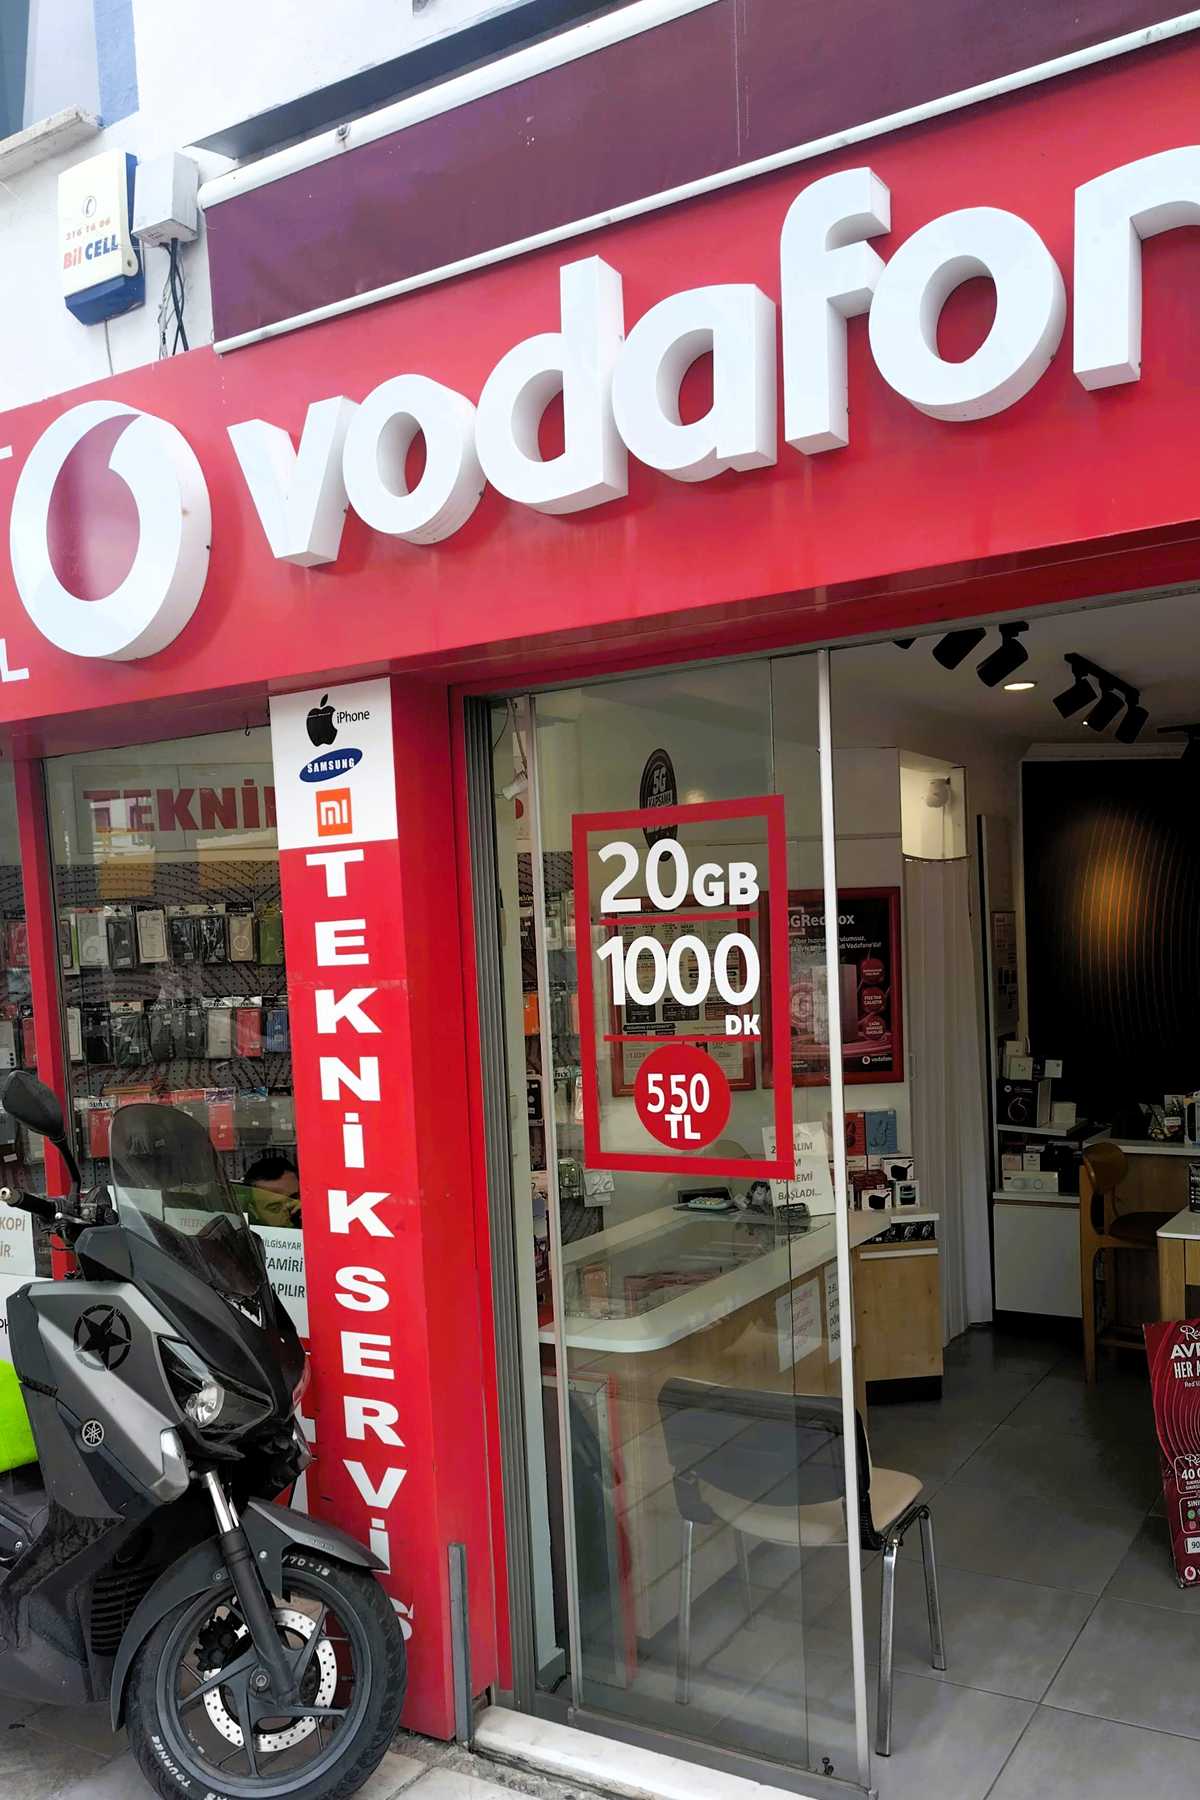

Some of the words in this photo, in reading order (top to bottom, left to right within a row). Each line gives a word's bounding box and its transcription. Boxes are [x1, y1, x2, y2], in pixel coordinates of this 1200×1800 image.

[336, 709, 370, 724] iPhone
[307, 757, 355, 773] SAMSUNG
[596, 932, 761, 1008] 1000
[724, 1014, 761, 1036] DK
[305, 849, 396, 1239] TEKNİK
[646, 1072, 711, 1115] 550
[663, 1112, 701, 1140] TL
[264, 1239, 302, 1250] İLGİSAYAR
[270, 1282, 305, 1298] APILIR
[1173, 1361, 1194, 1379] HER
[1181, 1469, 1196, 1480] 40
